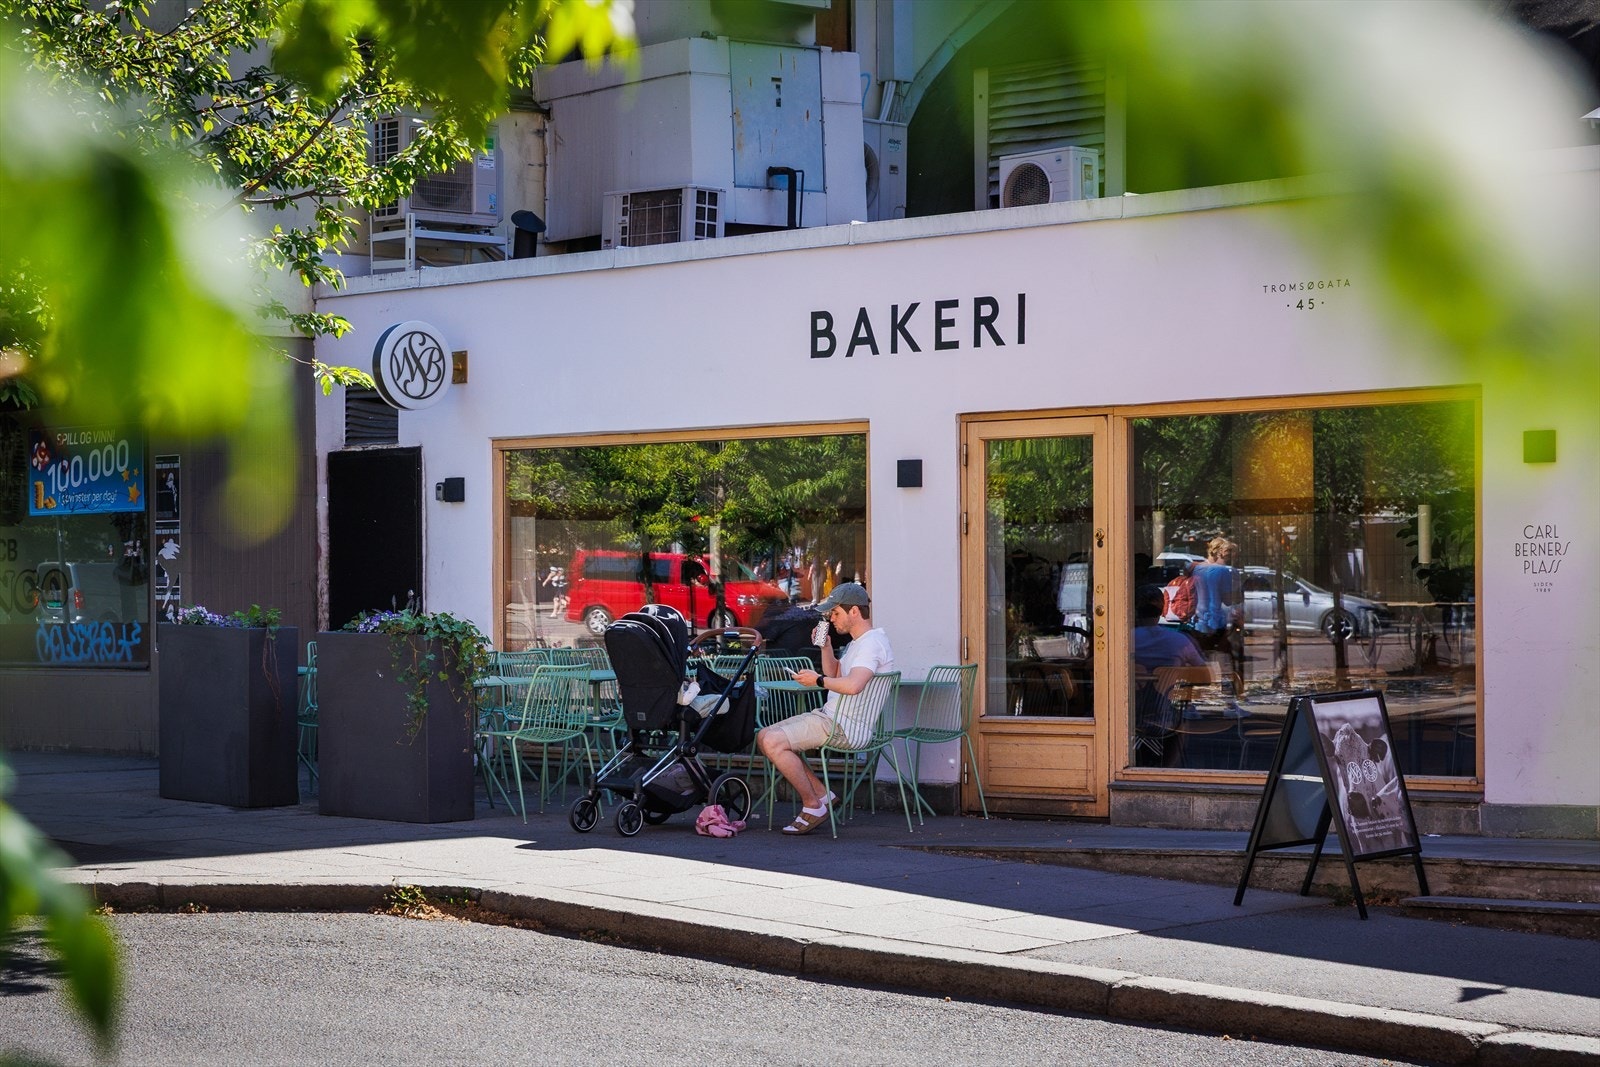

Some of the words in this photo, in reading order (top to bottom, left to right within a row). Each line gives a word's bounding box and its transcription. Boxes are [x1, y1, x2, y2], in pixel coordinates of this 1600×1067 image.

[1262, 279, 1351, 294] TROMSØGATA
[810, 293, 1026, 359] BAKERI
[56, 432, 79, 446] SPILL
[80, 431, 92, 445] OG
[93, 429, 116, 443] VINN!
[47, 439, 129, 495] 100.000
[92, 493, 102, 504] per
[1523, 524, 1559, 539] CARL
[1514, 541, 1571, 557] BERNERS
[1523, 560, 1562, 574] PLASS
